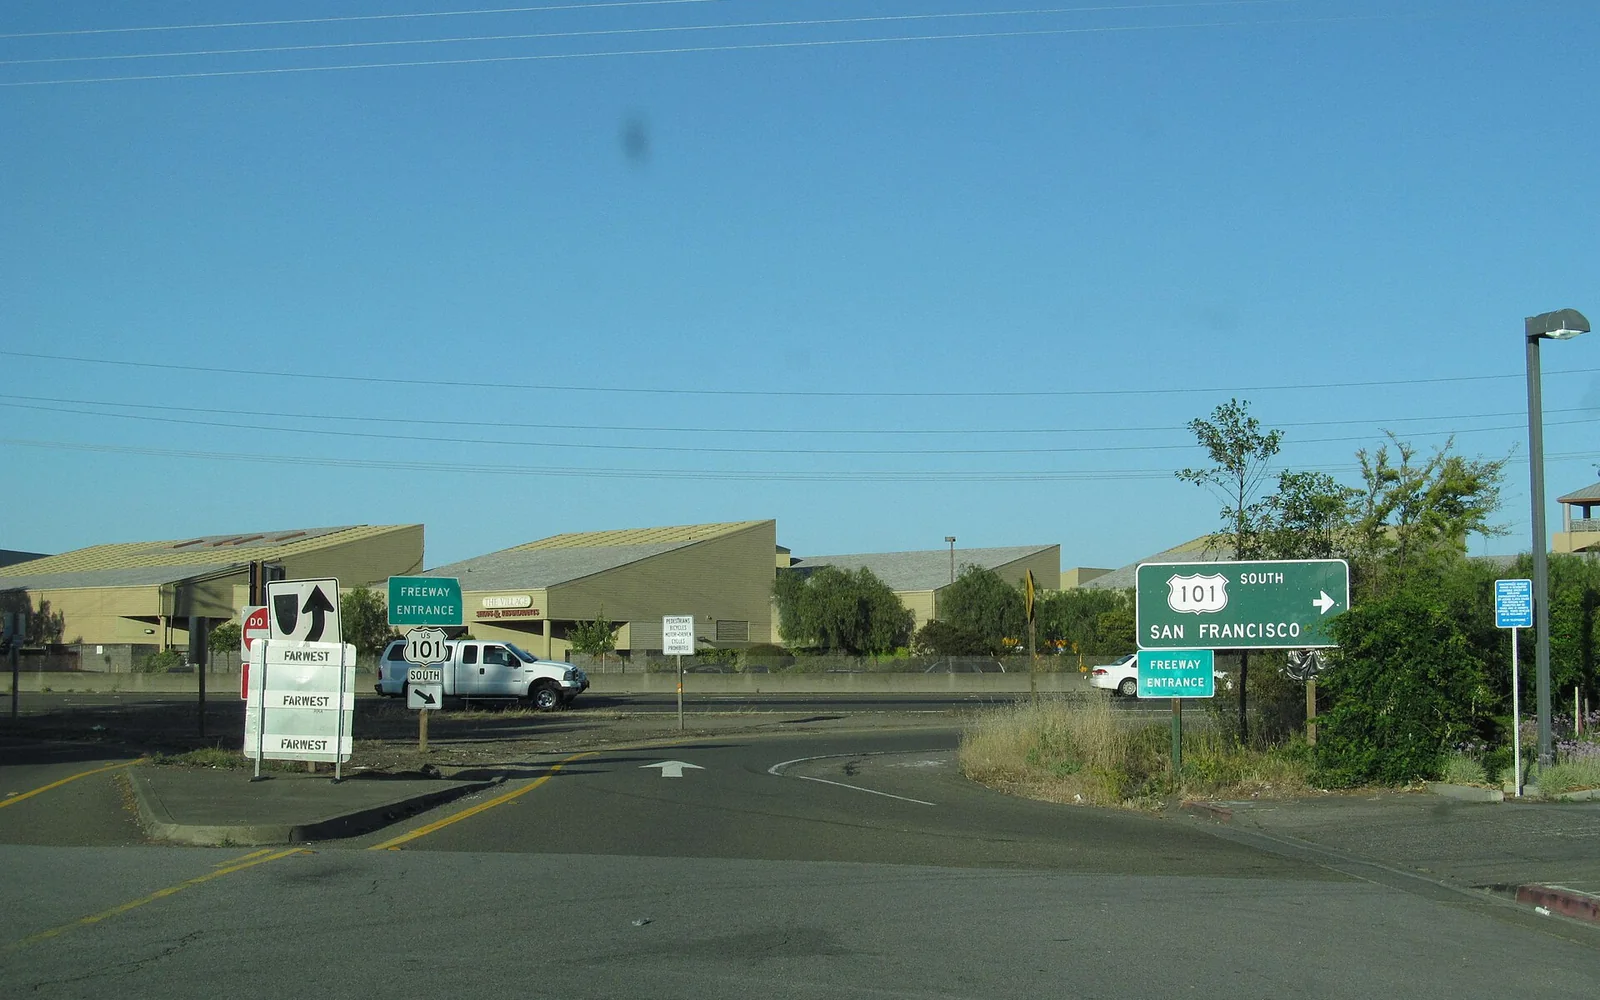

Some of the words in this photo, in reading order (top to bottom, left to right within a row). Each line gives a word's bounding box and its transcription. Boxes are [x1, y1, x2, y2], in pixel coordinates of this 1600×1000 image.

[1240, 572, 1284, 585] SOUTH
[400, 586, 451, 597] FREEWAY
[1181, 585, 1215, 603] 101
[485, 598, 498, 607] THE
[396, 605, 455, 615] ENTRANCE
[250, 617, 263, 626] DO
[1150, 625, 1184, 639] SAN
[1199, 623, 1300, 639] FRANCISCO
[411, 640, 440, 658] 101
[284, 650, 330, 662] FARWEST
[1150, 660, 1201, 670] FREEWAY
[410, 670, 440, 680] SOUTH
[1147, 677, 1205, 688] ENTRANCE
[283, 695, 330, 707] FARWEST
[280, 738, 328, 751] FARWEST
